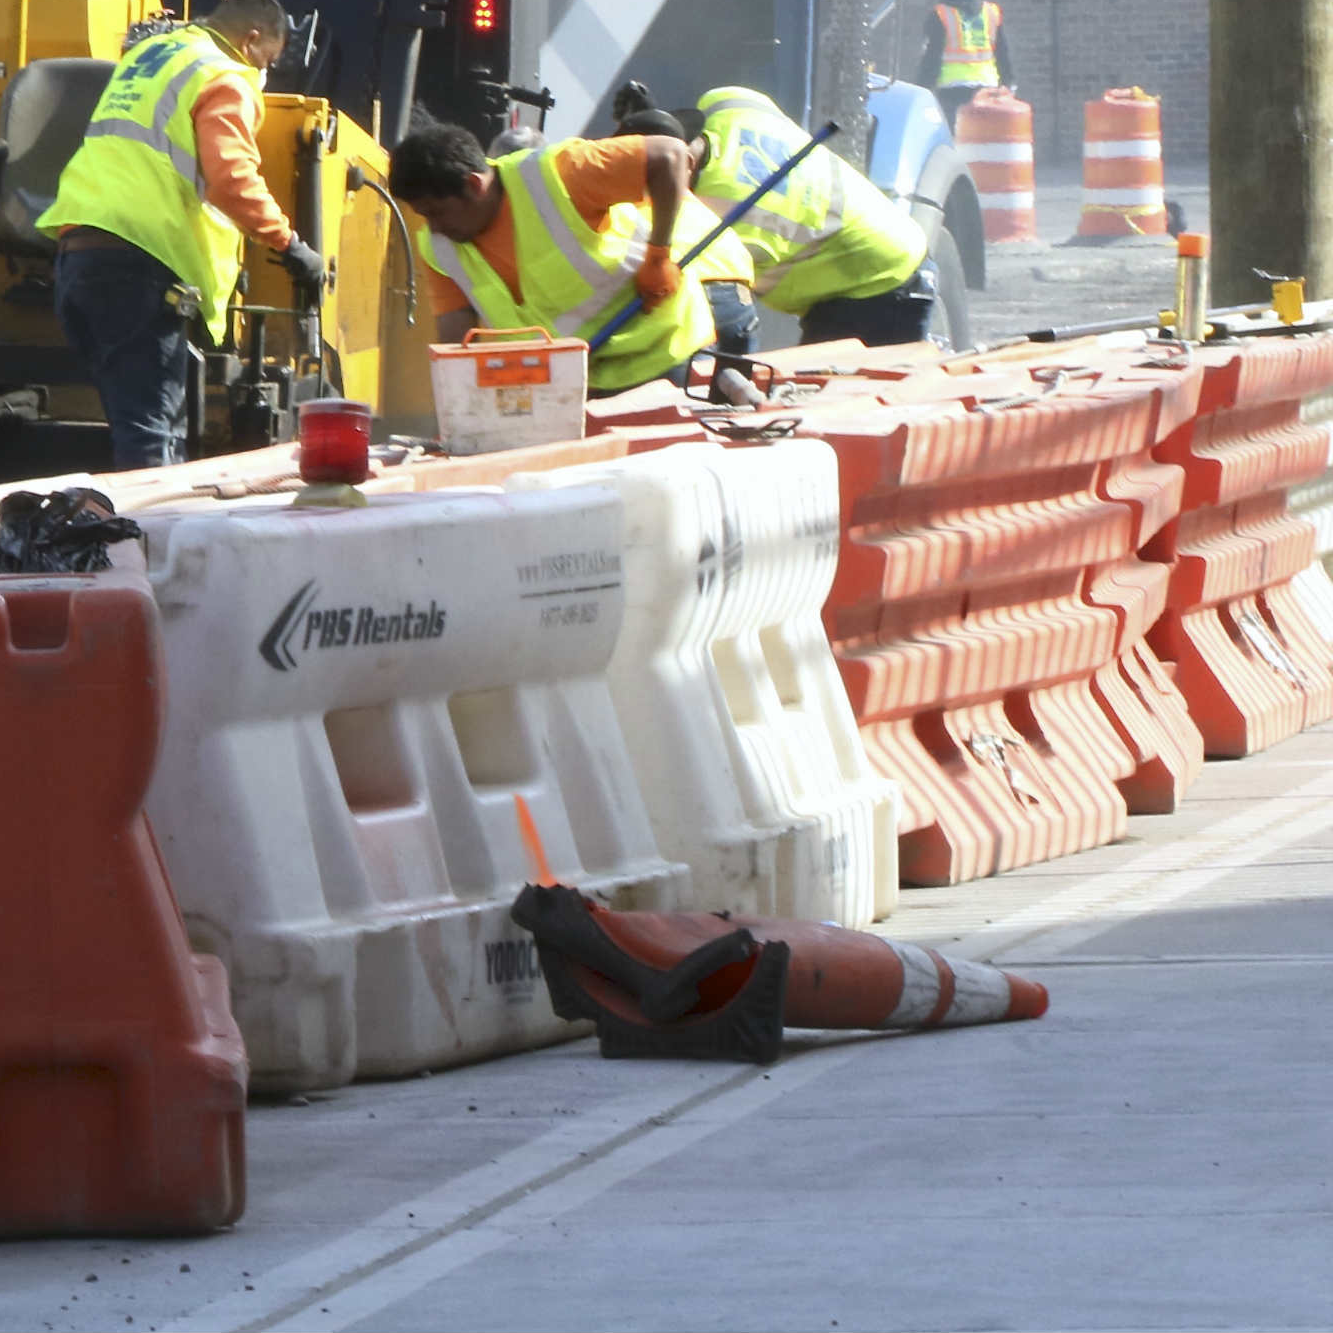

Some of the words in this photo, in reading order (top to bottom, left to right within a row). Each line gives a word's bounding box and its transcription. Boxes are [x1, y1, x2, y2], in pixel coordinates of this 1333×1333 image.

[302, 607, 352, 651] PBS
[352, 599, 447, 646] Rentals
[484, 939, 542, 985] YODOC
